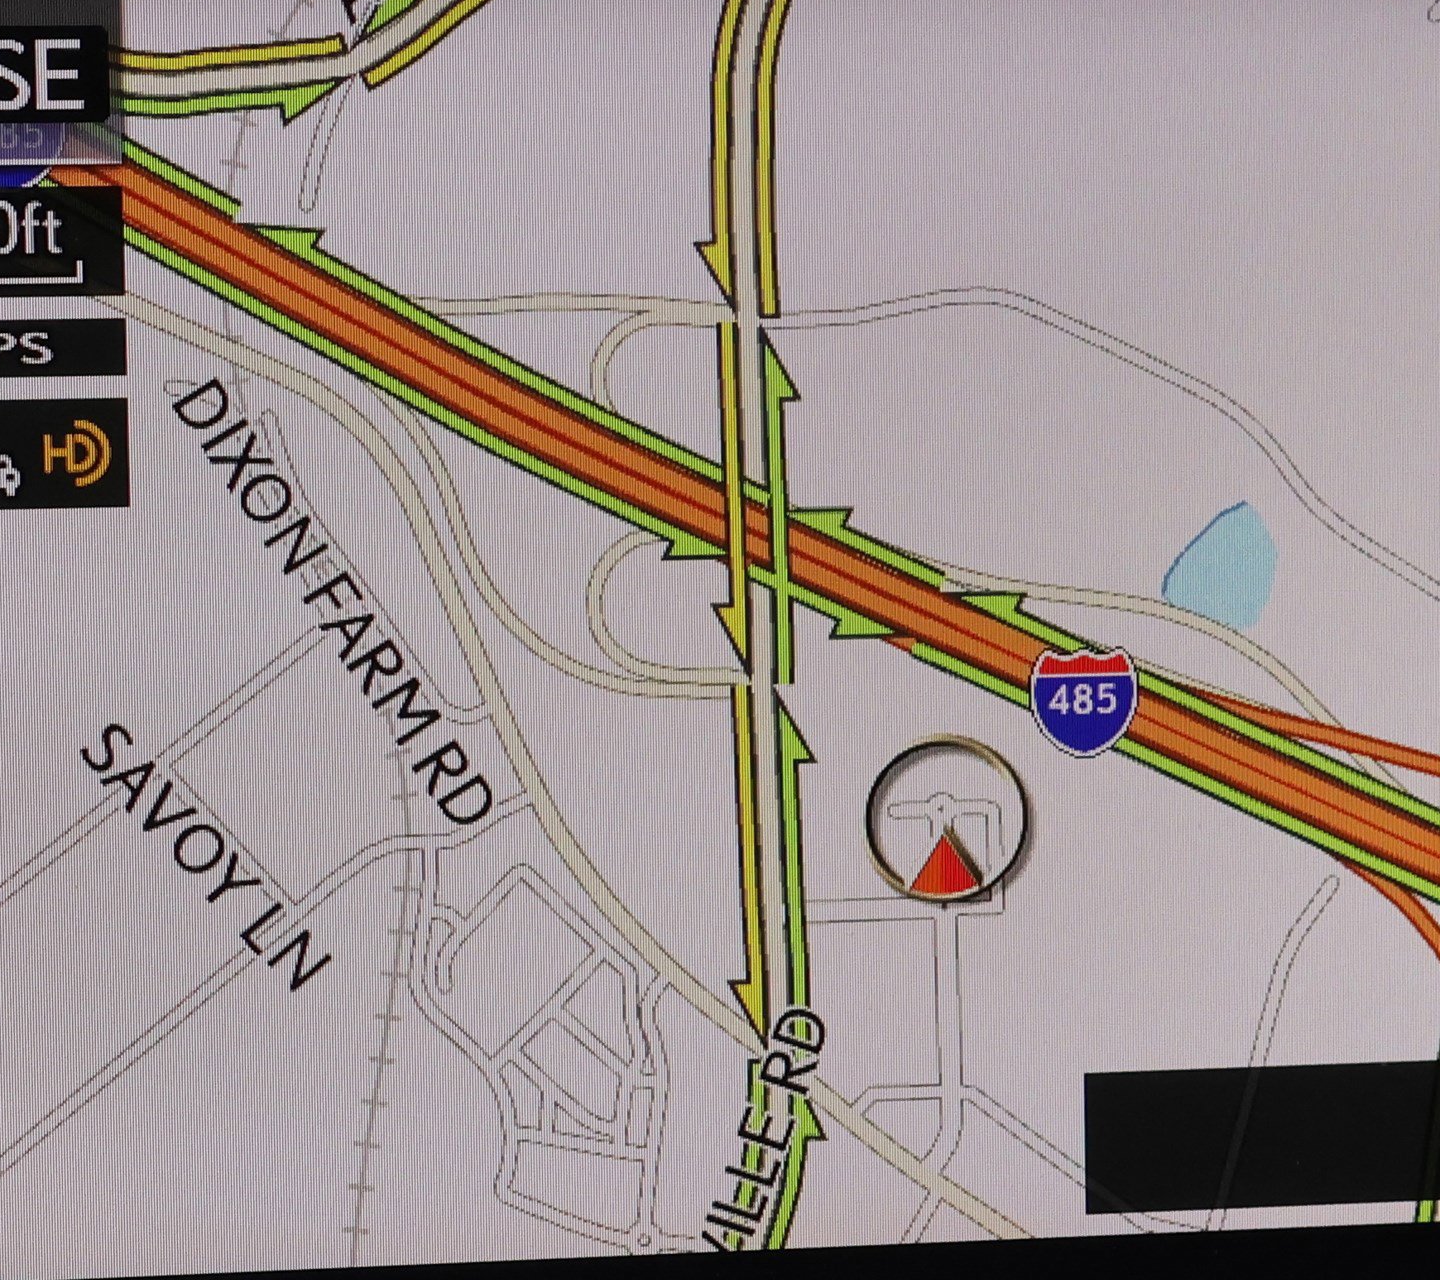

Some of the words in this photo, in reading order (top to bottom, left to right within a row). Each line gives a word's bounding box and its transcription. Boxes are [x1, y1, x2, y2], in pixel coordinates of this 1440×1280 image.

[172, 378, 328, 575] DIXON
[302, 572, 442, 746] FARM
[412, 741, 494, 825] RD
[1048, 680, 1118, 715] 485
[80, 723, 264, 903] SAVOY
[239, 903, 332, 991] LN
[760, 1009, 826, 1095] RD
